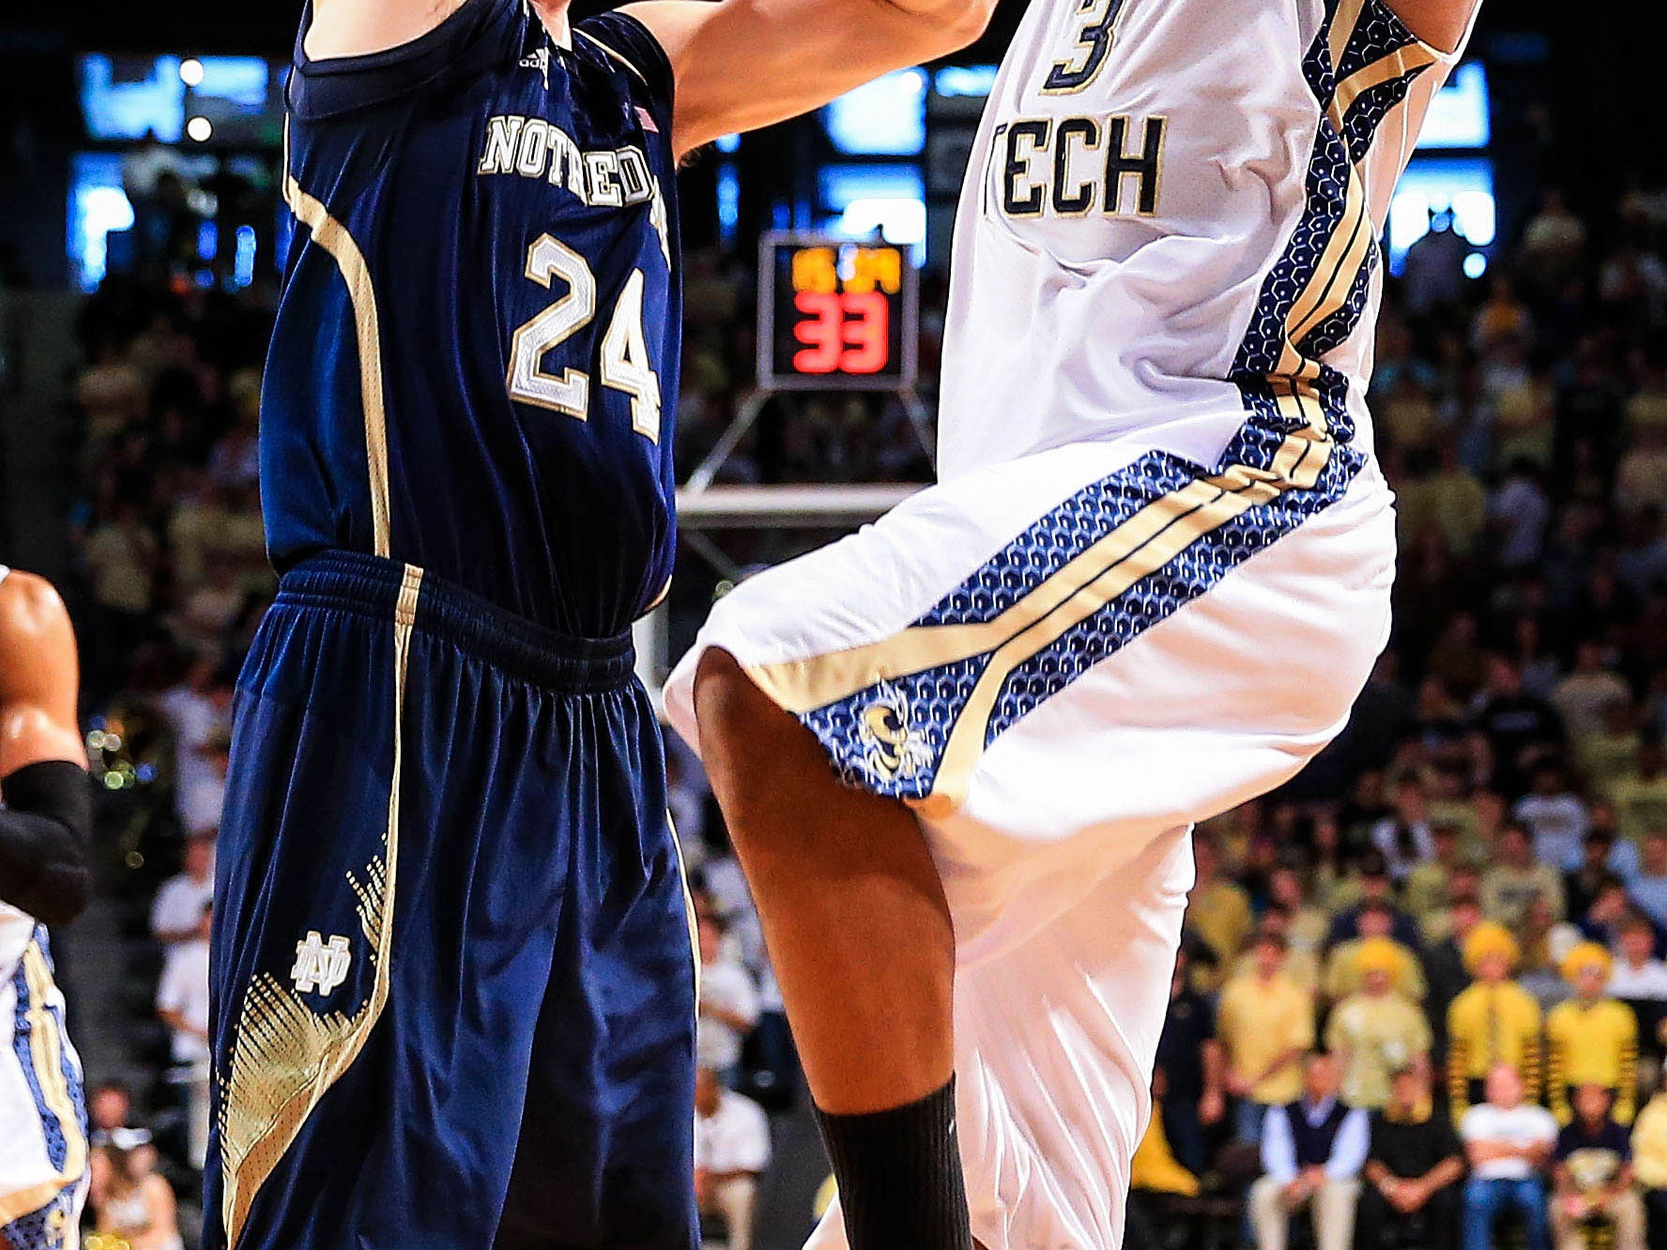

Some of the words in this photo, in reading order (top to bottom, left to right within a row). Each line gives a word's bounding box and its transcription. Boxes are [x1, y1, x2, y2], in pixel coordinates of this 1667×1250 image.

[983, 114, 1168, 220] ECH
[506, 232, 661, 446] 24
[792, 290, 889, 374] 33
